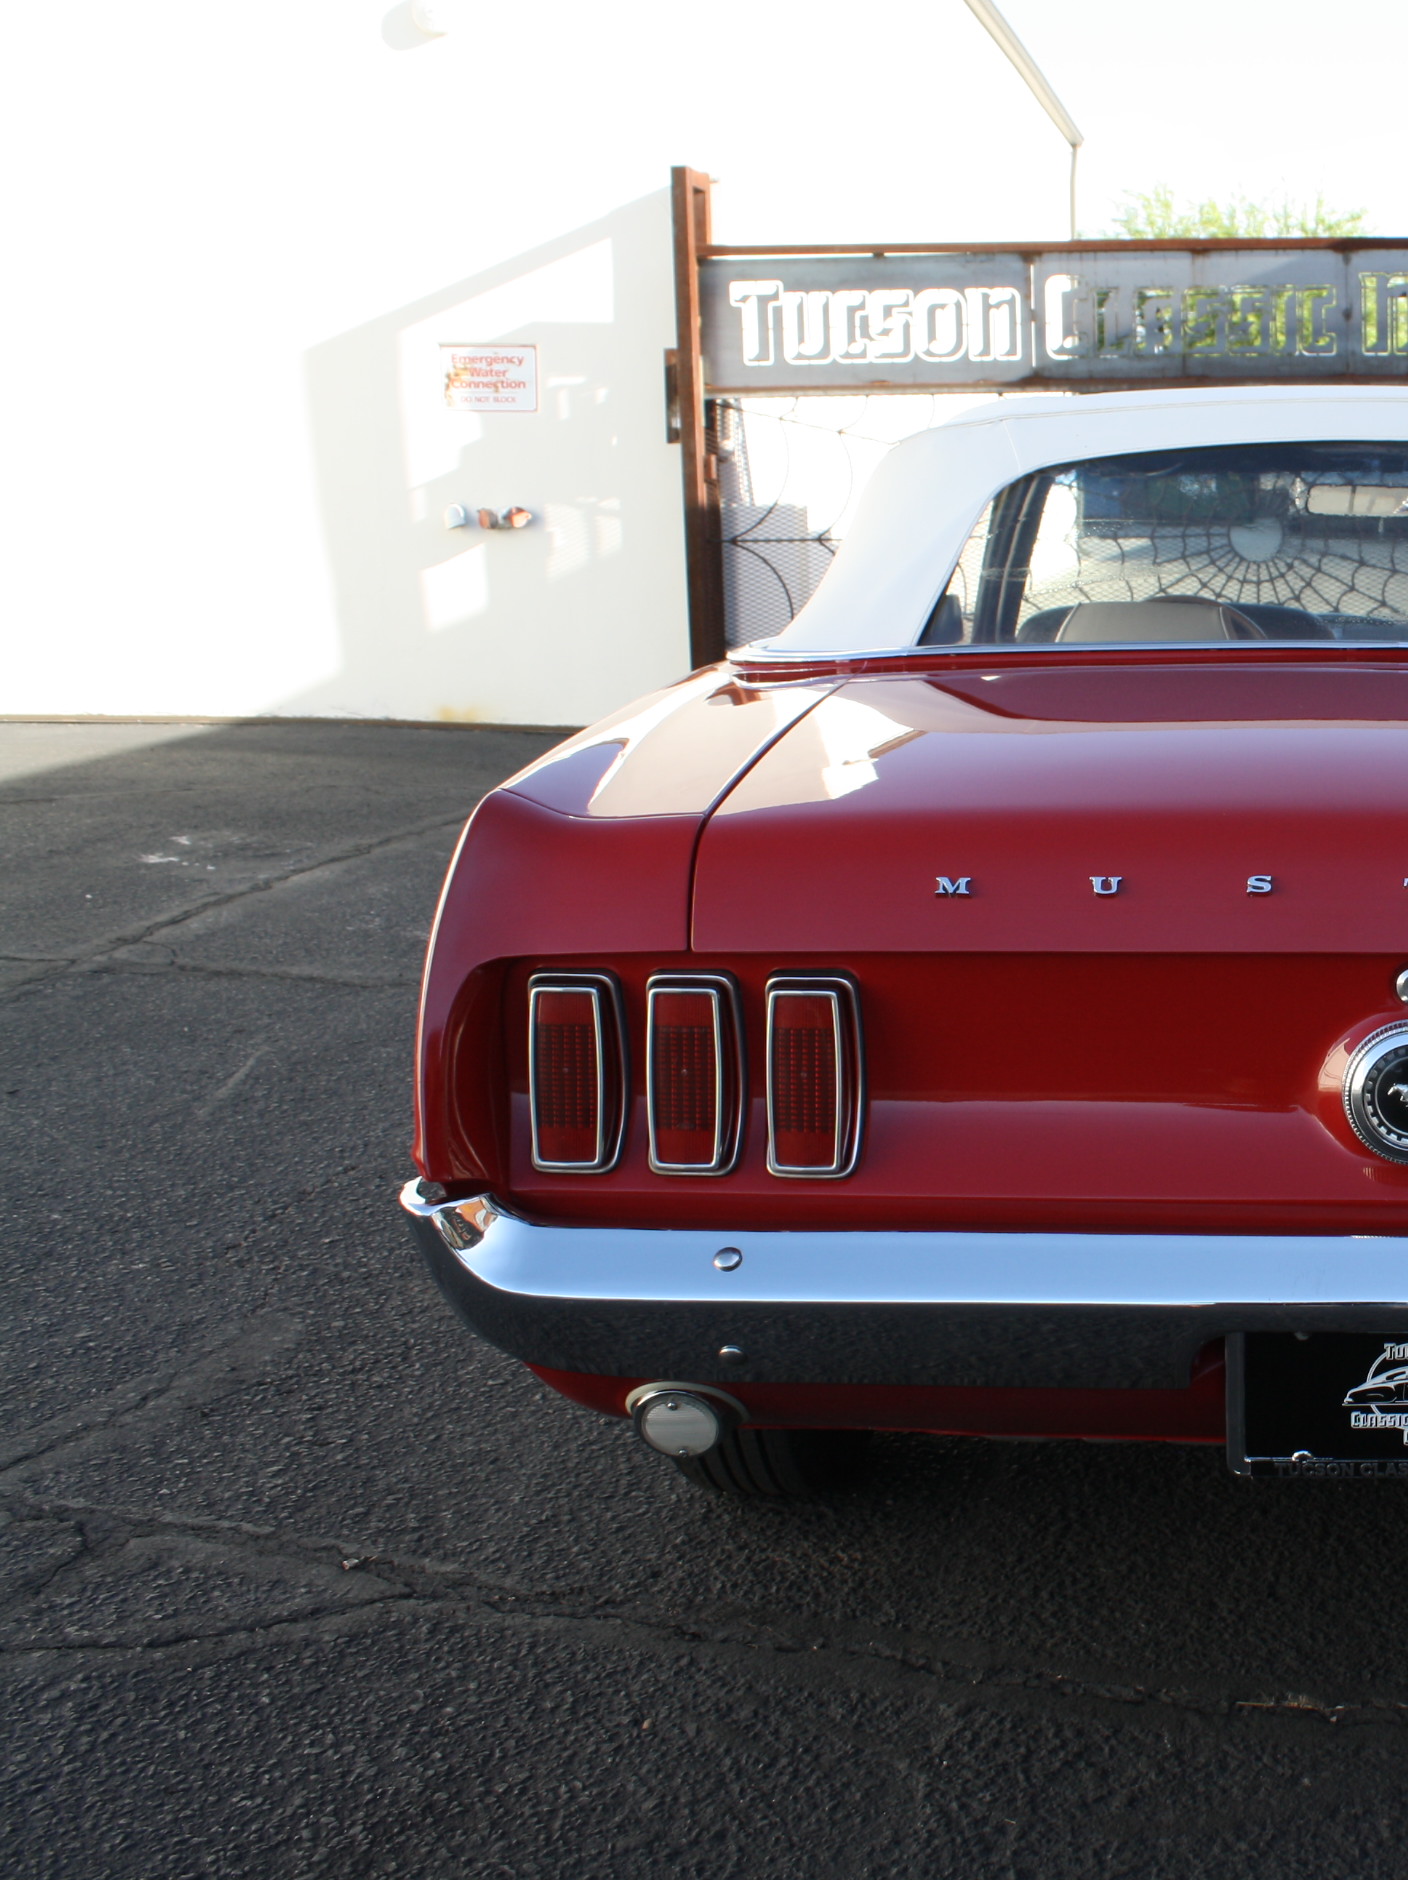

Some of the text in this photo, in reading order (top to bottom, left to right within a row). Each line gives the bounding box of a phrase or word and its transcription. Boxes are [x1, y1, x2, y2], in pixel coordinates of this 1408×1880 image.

[451, 354, 525, 366] Emergency
[468, 367, 508, 378] Water
[450, 379, 527, 389] Connection
[1274, 1462, 1355, 1478] TUCSON
